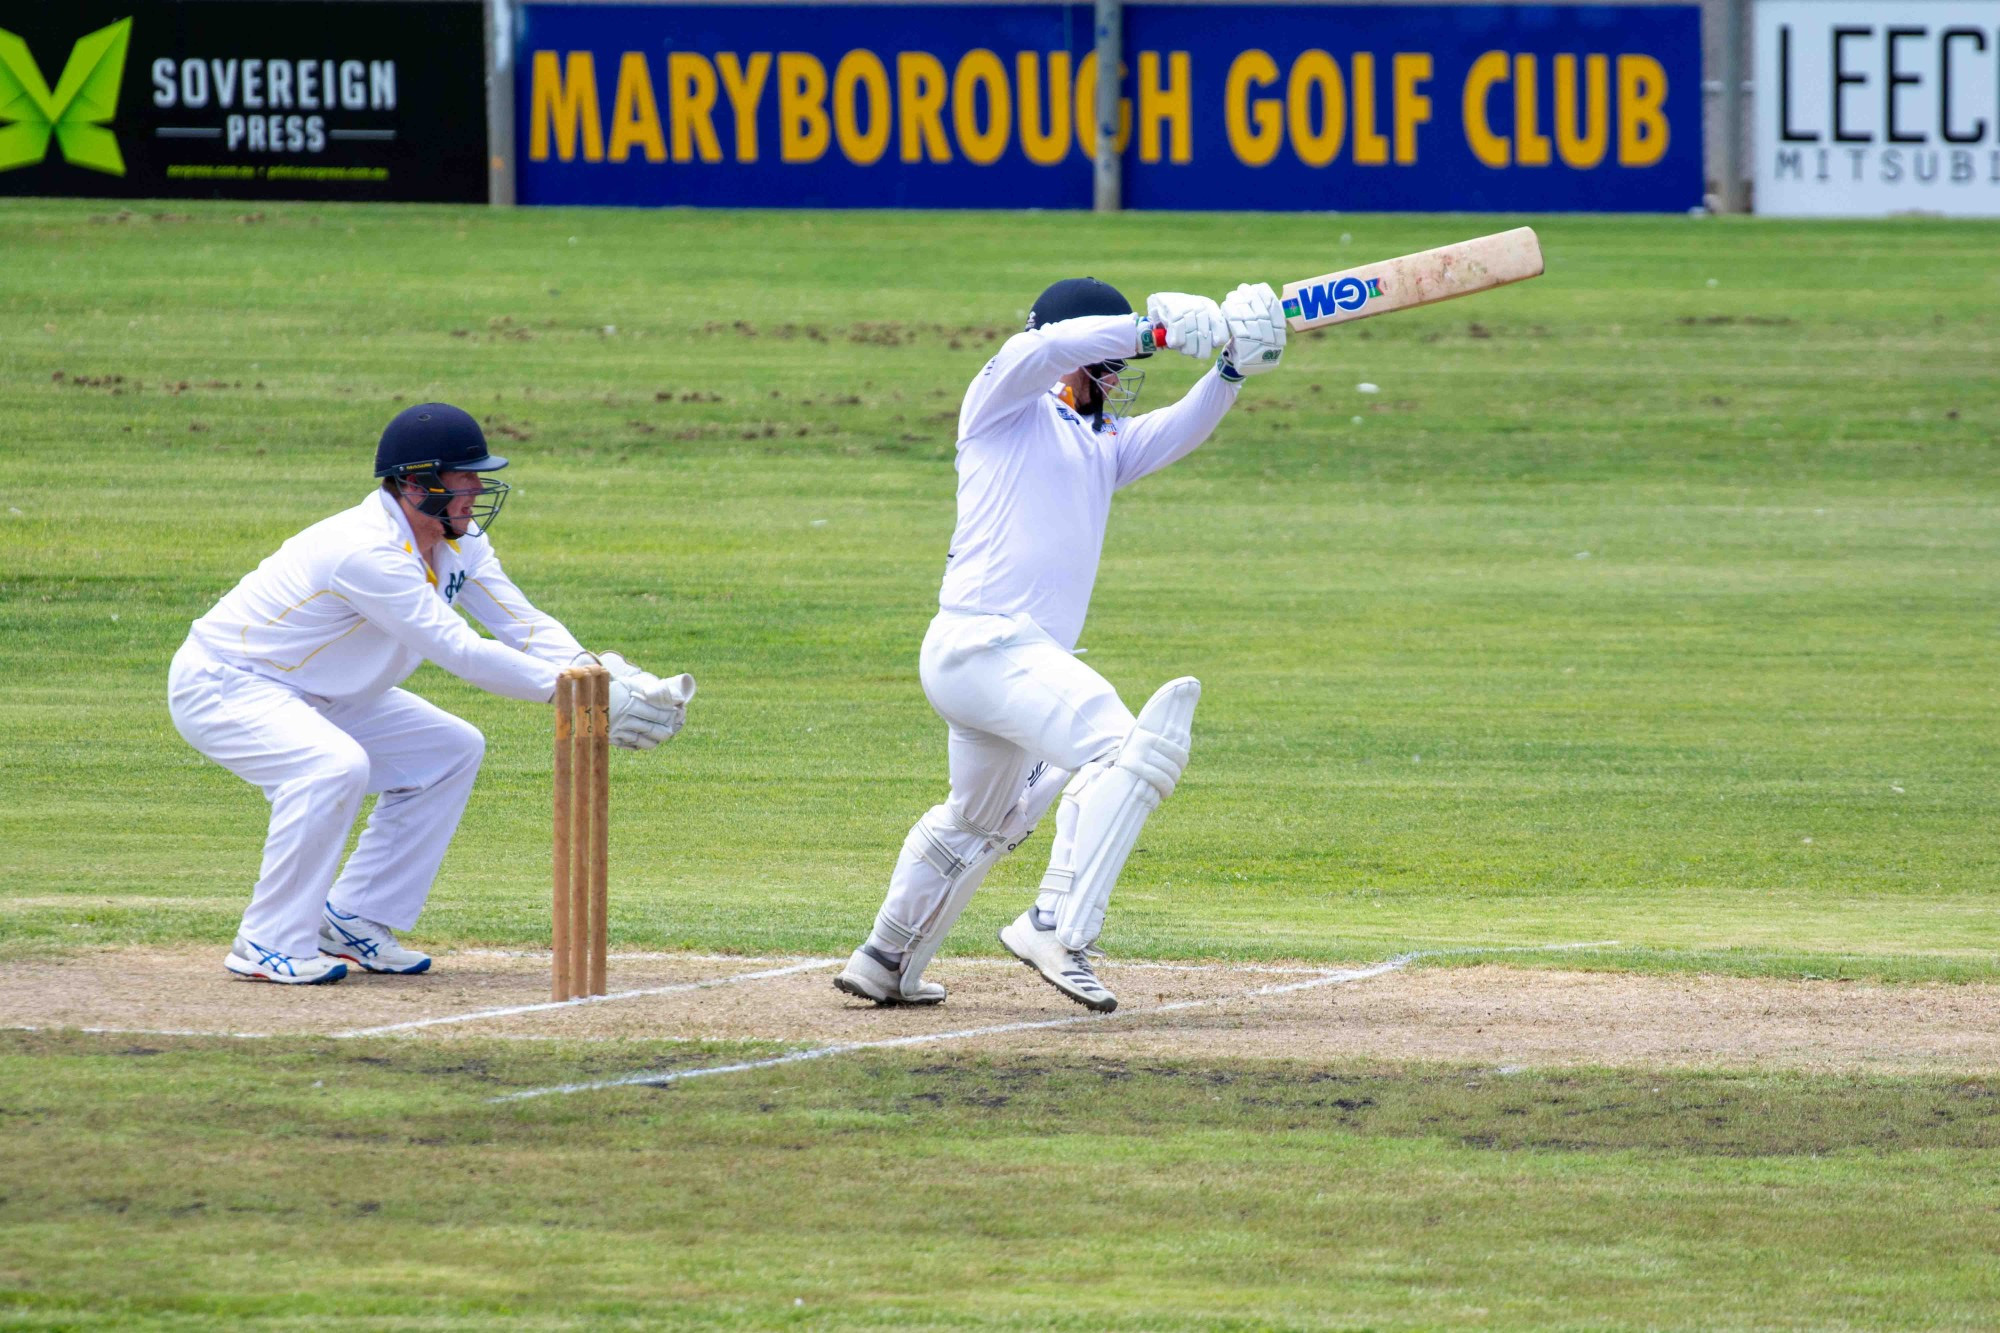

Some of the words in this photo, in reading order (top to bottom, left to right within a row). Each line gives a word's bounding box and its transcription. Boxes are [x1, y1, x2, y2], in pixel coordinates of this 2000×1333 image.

[151, 57, 397, 111] SOVEREIGN
[529, 48, 1192, 166] MARYBOROUGH
[1224, 48, 1433, 168] GOLF
[1462, 49, 1671, 169] CLUB
[1778, 25, 2000, 144] LEEC
[226, 114, 326, 152] PRESS
[1297, 277, 1368, 321] GM
